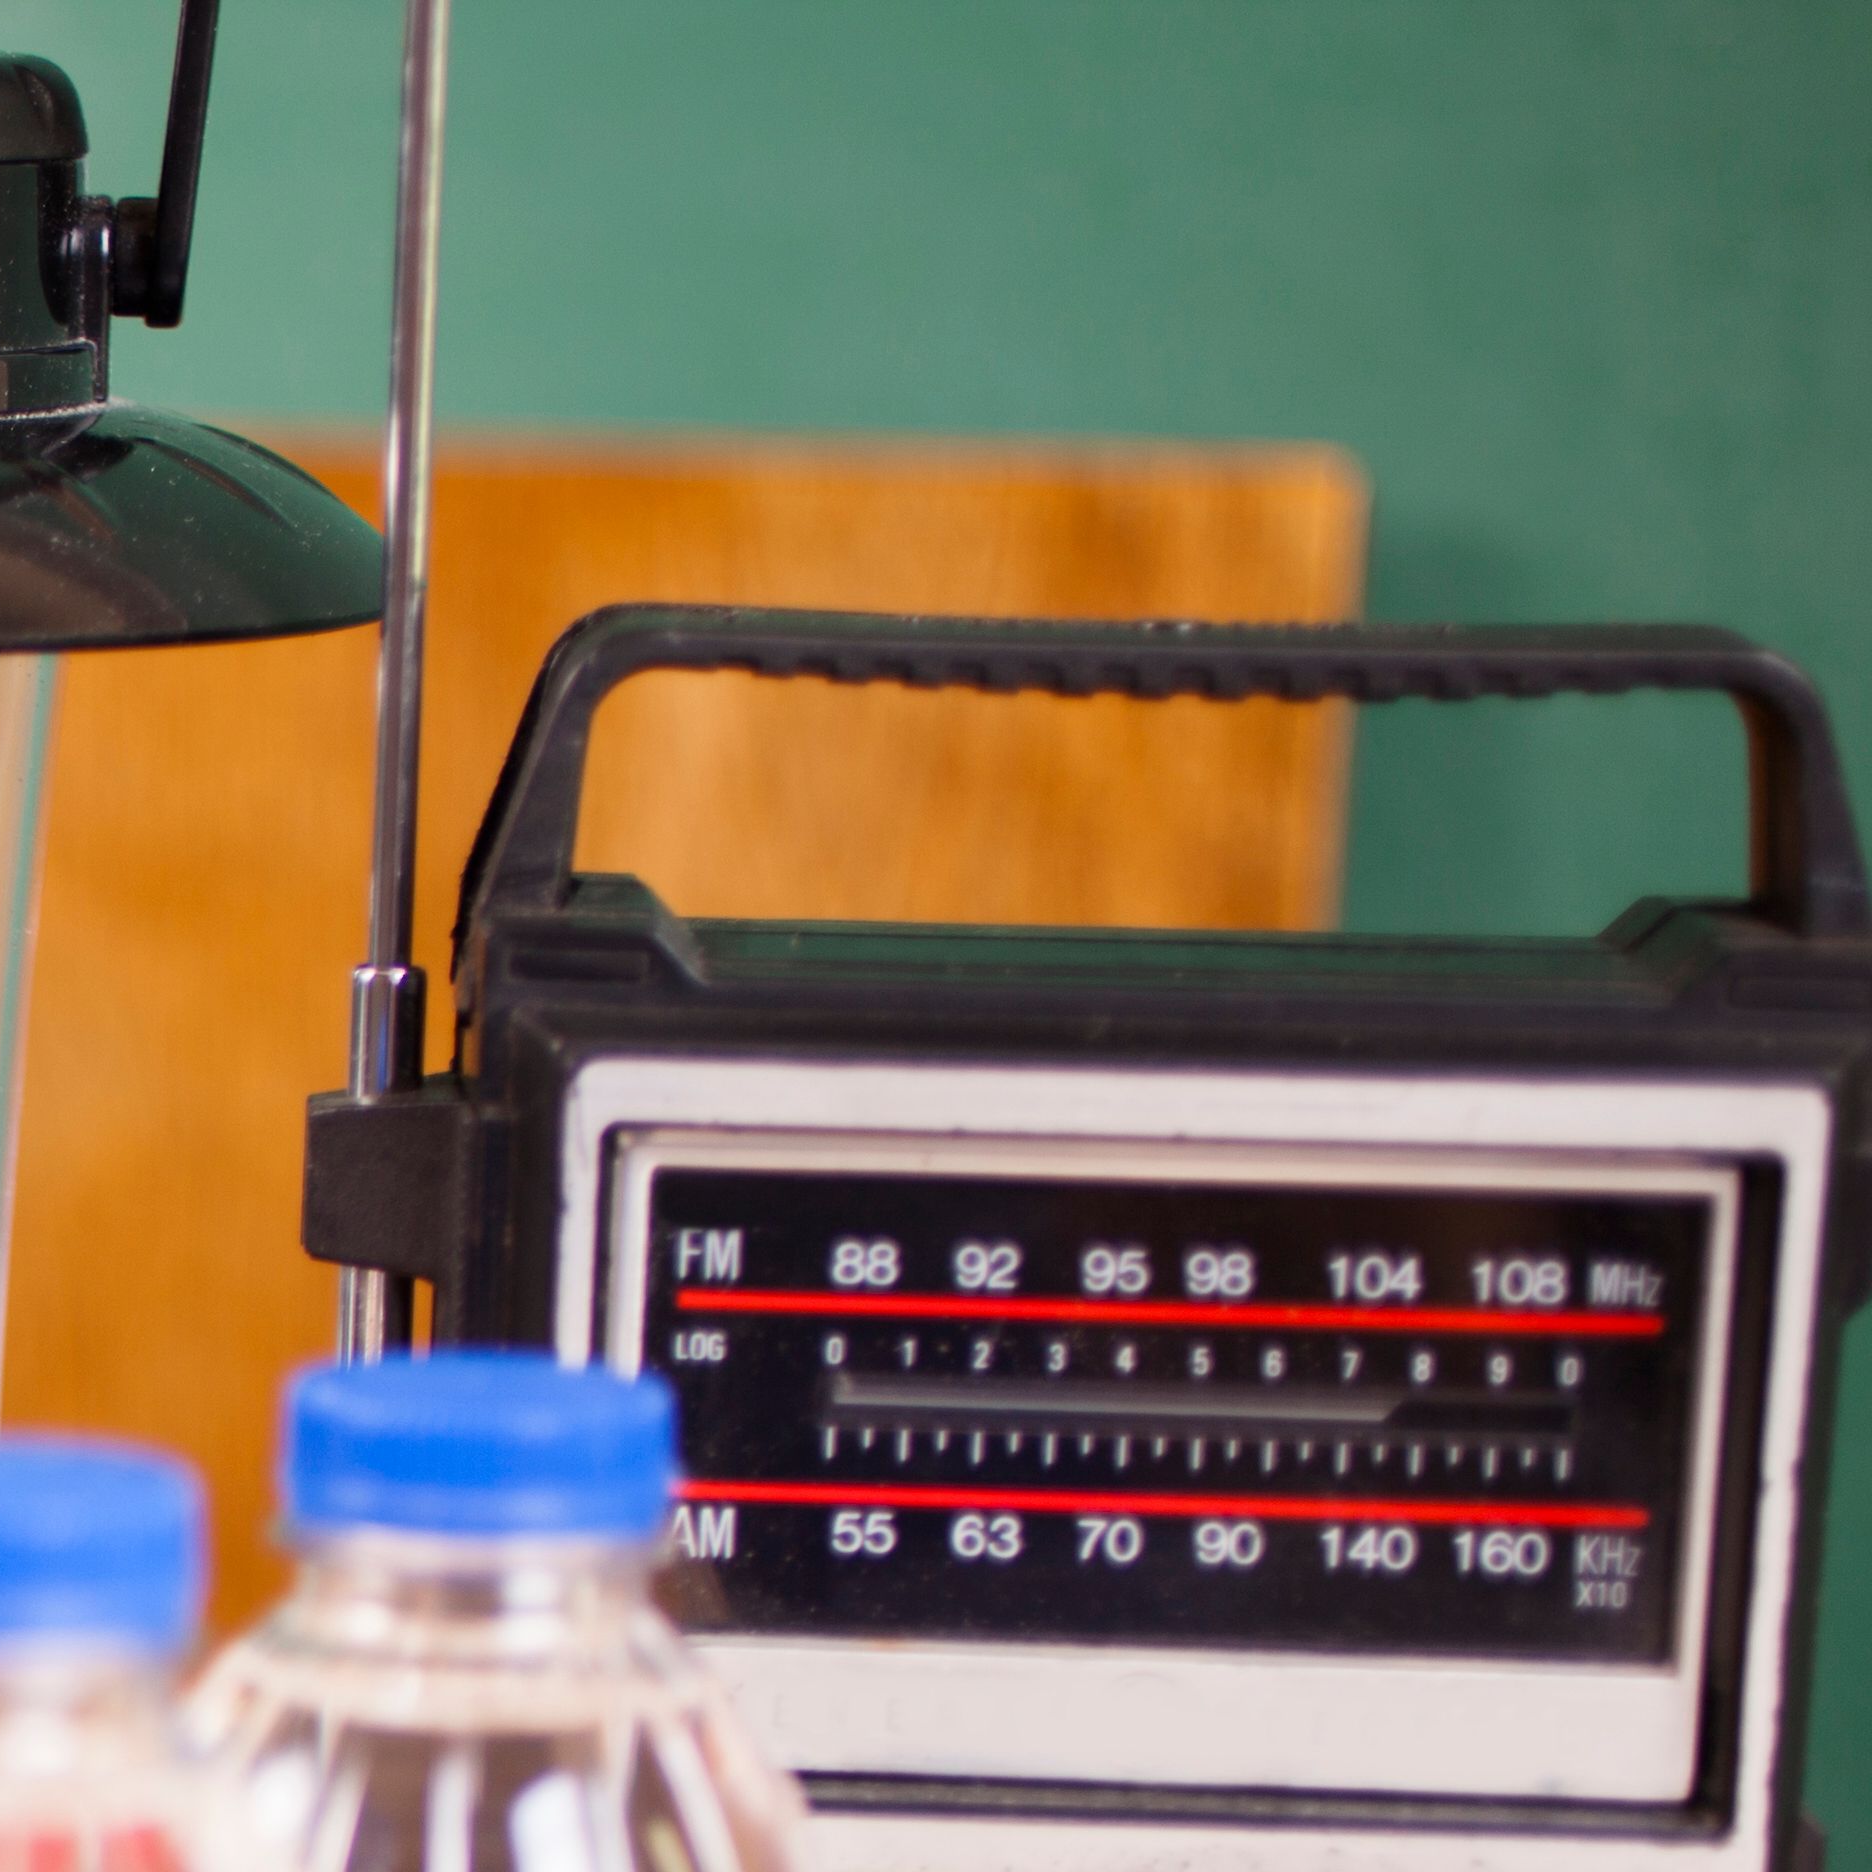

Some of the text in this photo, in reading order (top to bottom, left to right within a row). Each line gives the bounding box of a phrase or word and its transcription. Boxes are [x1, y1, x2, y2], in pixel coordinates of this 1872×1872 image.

[674, 1227, 1661, 1308] FM 88 92 95 98 104 108 MHz
[672, 1330, 727, 1364] LOG
[900, 1337, 917, 1368] 1
[971, 1338, 993, 1372] 2
[1046, 1340, 1068, 1374] 3
[1113, 1343, 1137, 1375] 4
[1189, 1344, 1212, 1378] 5
[1261, 1347, 1285, 1380] 6
[1341, 1348, 1361, 1381] 7
[1410, 1350, 1434, 1385] 8
[1487, 1352, 1511, 1387] 9
[670, 1503, 1643, 1579] AM 55 63 70 90 140 160 KHz
